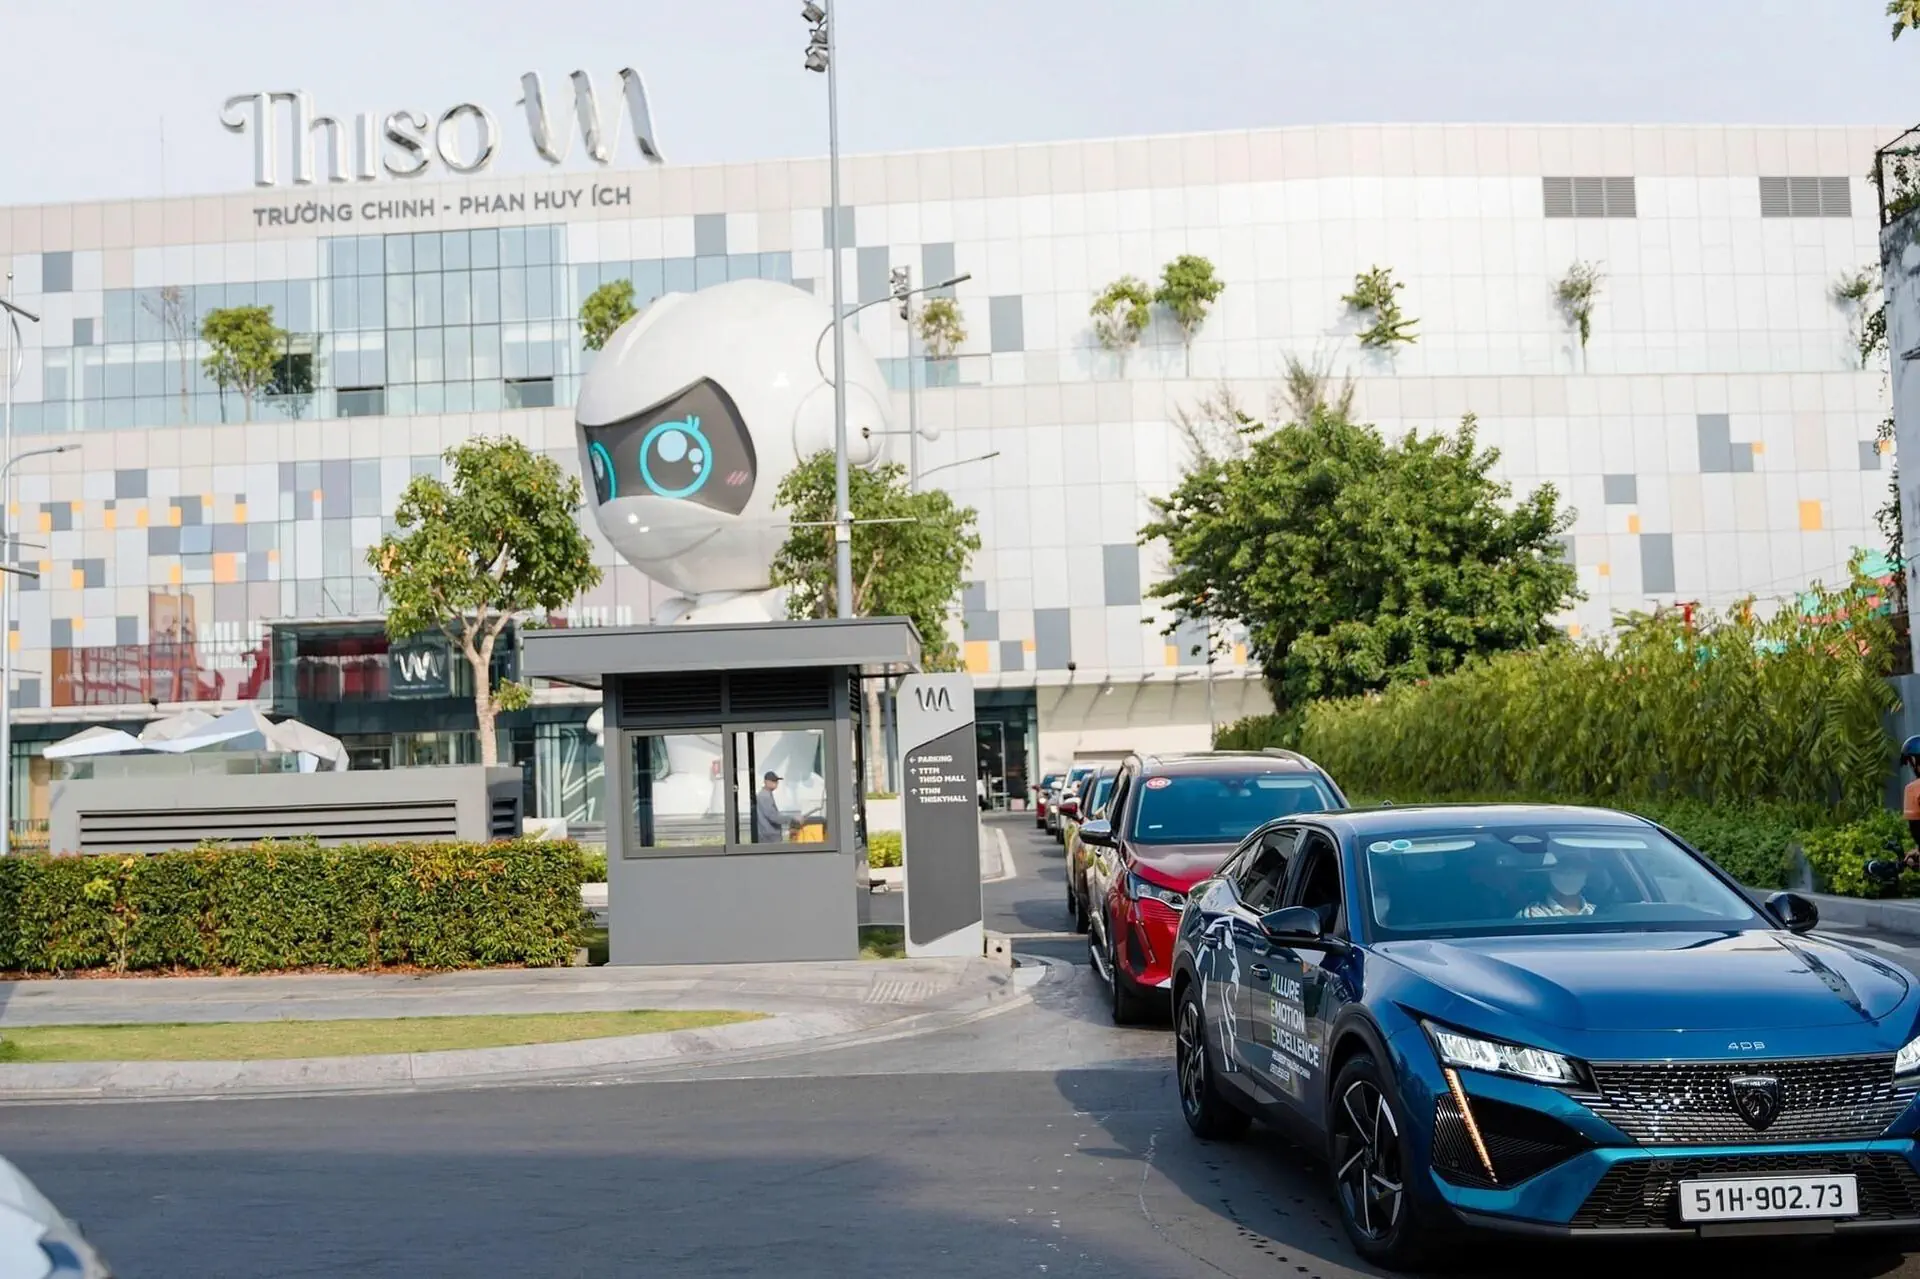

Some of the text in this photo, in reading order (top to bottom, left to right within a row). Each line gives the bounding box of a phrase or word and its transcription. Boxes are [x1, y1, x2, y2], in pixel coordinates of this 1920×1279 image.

[253, 199, 353, 227] TRƯỜNG
[361, 198, 435, 220] CHINH
[460, 193, 525, 215] PHAN
[534, 189, 582, 211] HUY
[591, 185, 631, 207] ÍCH
[917, 755, 953, 764] PARKING
[919, 774, 967, 784] THISO MALL
[1270, 973, 1301, 1002] ALLURE
[1270, 999, 1306, 1033] EMOTION
[1270, 1024, 1320, 1068] EXCELLENCE
[1695, 1183, 1843, 1213] 51H-902.73
